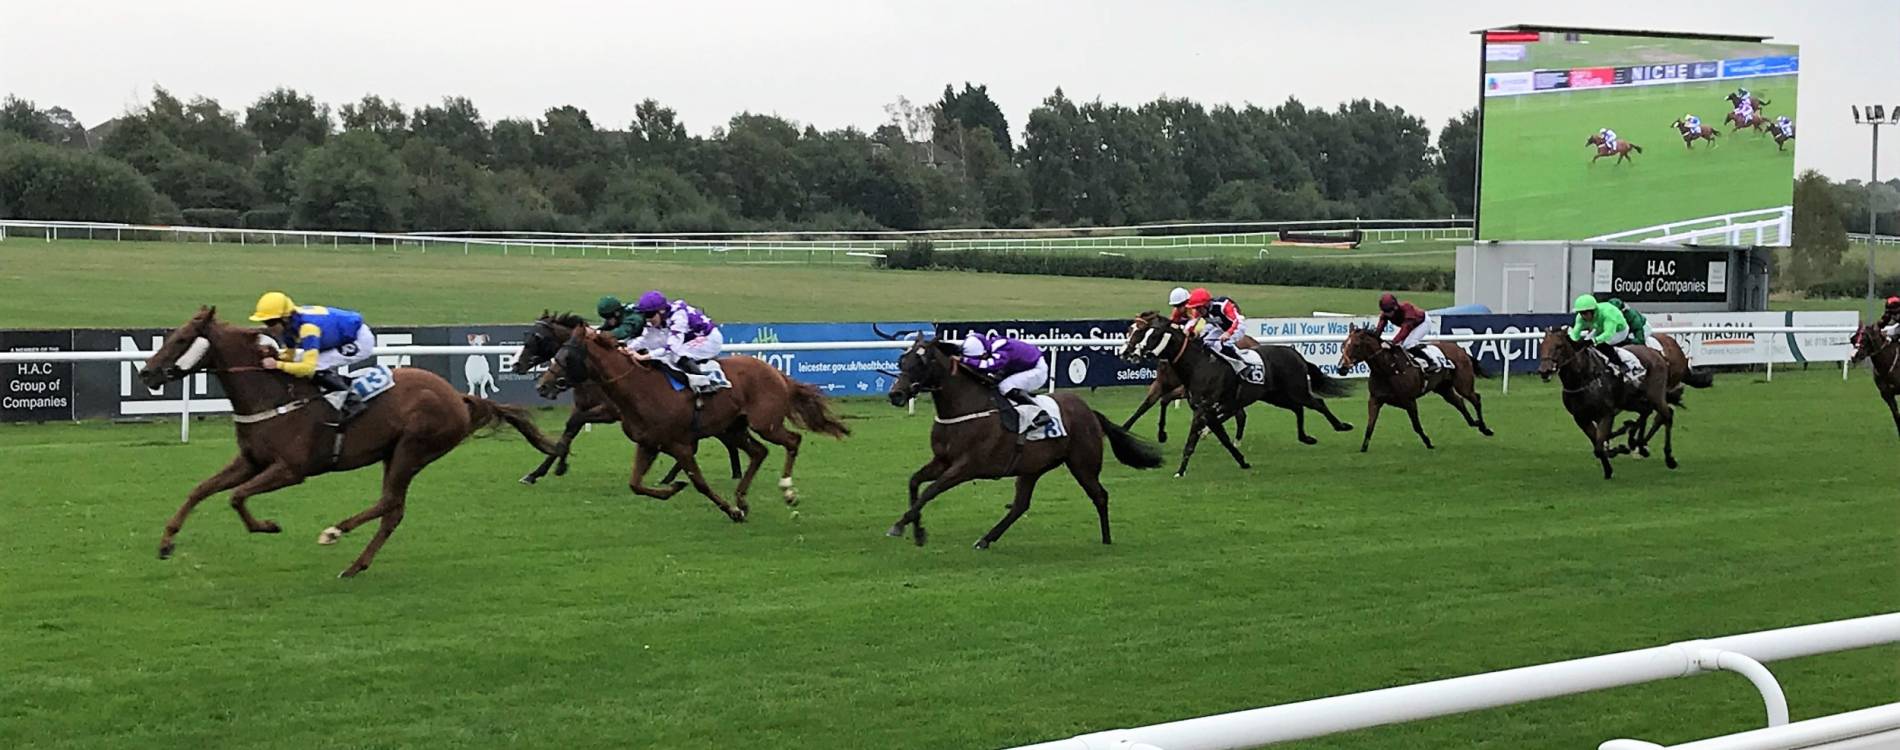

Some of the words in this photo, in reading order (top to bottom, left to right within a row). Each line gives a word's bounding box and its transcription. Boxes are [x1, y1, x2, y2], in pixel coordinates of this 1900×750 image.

[1631, 64, 1688, 80] NICHE
[1647, 260, 1676, 276] H.A.C
[1614, 277, 1643, 295] Group
[1644, 277, 1655, 292] of
[1656, 277, 1706, 295] Companies
[1260, 323, 1280, 336] For
[1282, 322, 1297, 335] All
[1300, 322, 1325, 335] Your
[1701, 322, 1755, 340] MAGMA
[1320, 343, 1338, 355] 350
[18, 362, 53, 375] H.A.C
[10, 379, 46, 394] Group
[49, 378, 61, 391] of
[3, 395, 68, 410] Companies
